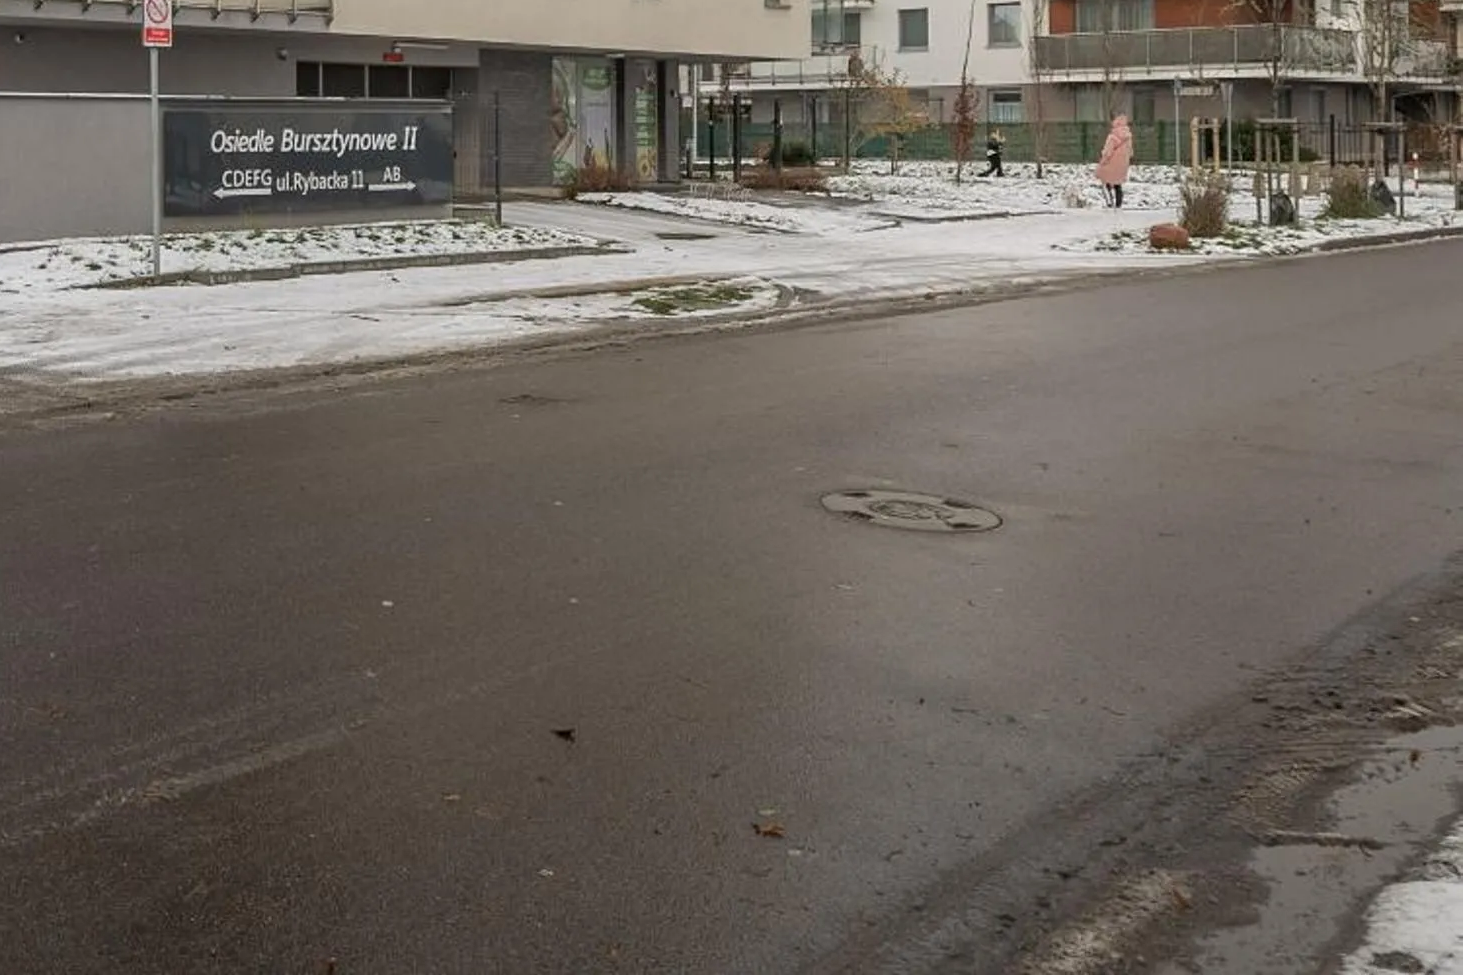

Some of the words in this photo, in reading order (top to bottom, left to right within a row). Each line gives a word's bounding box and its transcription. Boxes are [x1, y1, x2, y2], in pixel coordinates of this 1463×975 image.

[210, 129, 274, 153] Osiedle
[280, 128, 397, 158] Bursztynowe
[402, 126, 418, 151] II
[222, 170, 272, 188] CDEFG
[276, 170, 348, 195] ul.Rybacka
[351, 170, 364, 188] 11
[383, 166, 401, 182] AB
